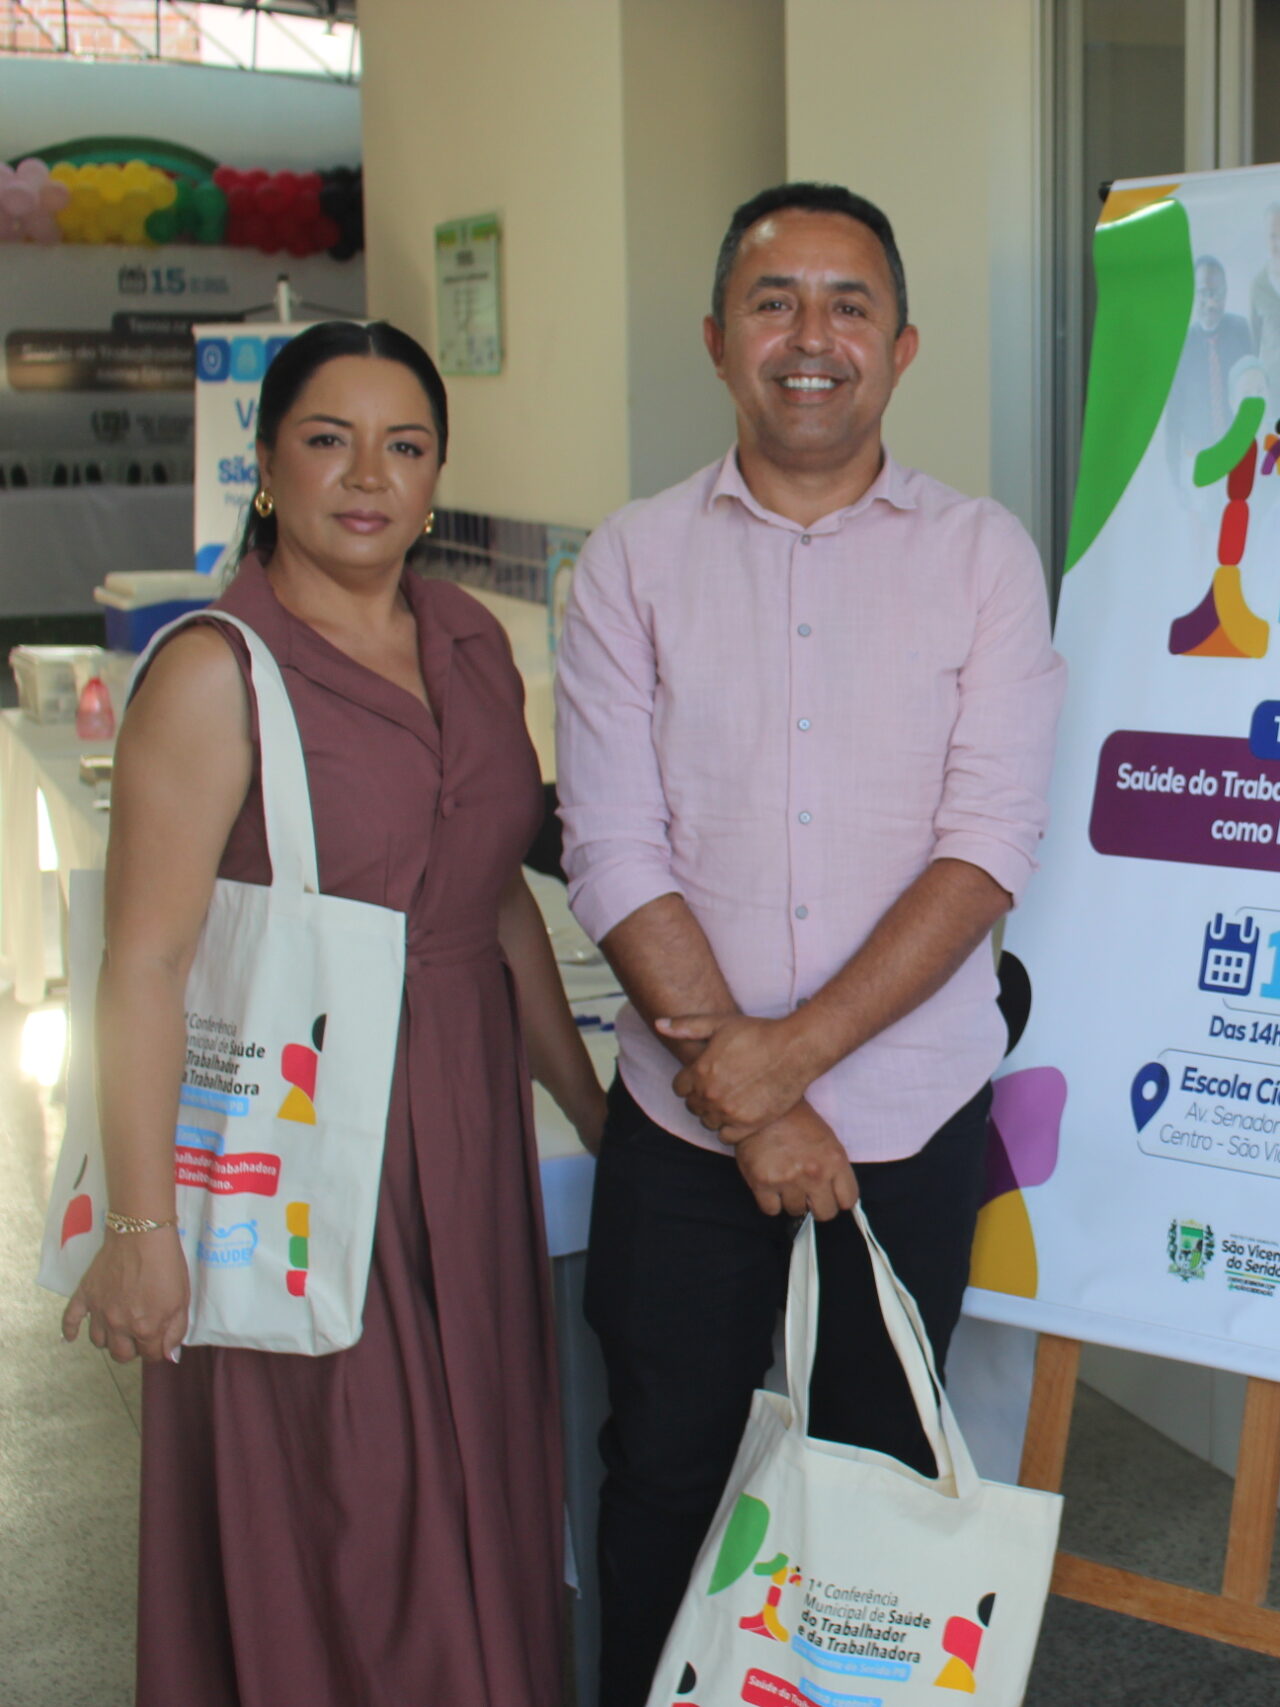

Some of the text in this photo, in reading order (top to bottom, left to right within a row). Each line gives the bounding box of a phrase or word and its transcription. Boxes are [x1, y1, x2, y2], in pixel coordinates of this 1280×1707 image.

[151, 266, 186, 294] 15
[1116, 762, 1185, 794] Saúde
[1188, 769, 1219, 797] do
[1211, 817, 1273, 845] como
[1208, 1014, 1246, 1041] Das
[1180, 1065, 1251, 1102] Escola
[1184, 1101, 1208, 1123] Av.
[1159, 1123, 1214, 1152] Centro
[1227, 1134, 1260, 1160] São
[1221, 1239, 1245, 1256] São
[1226, 1256, 1243, 1270] do
[824, 1583, 899, 1607] Conferência
[804, 1592, 932, 1629] Municipal de Saúde
[801, 1609, 908, 1643] do Trabalhador
[797, 1624, 805, 1637] e
[807, 1629, 823, 1648] da
[826, 1636, 922, 1664] Trabalhadora
